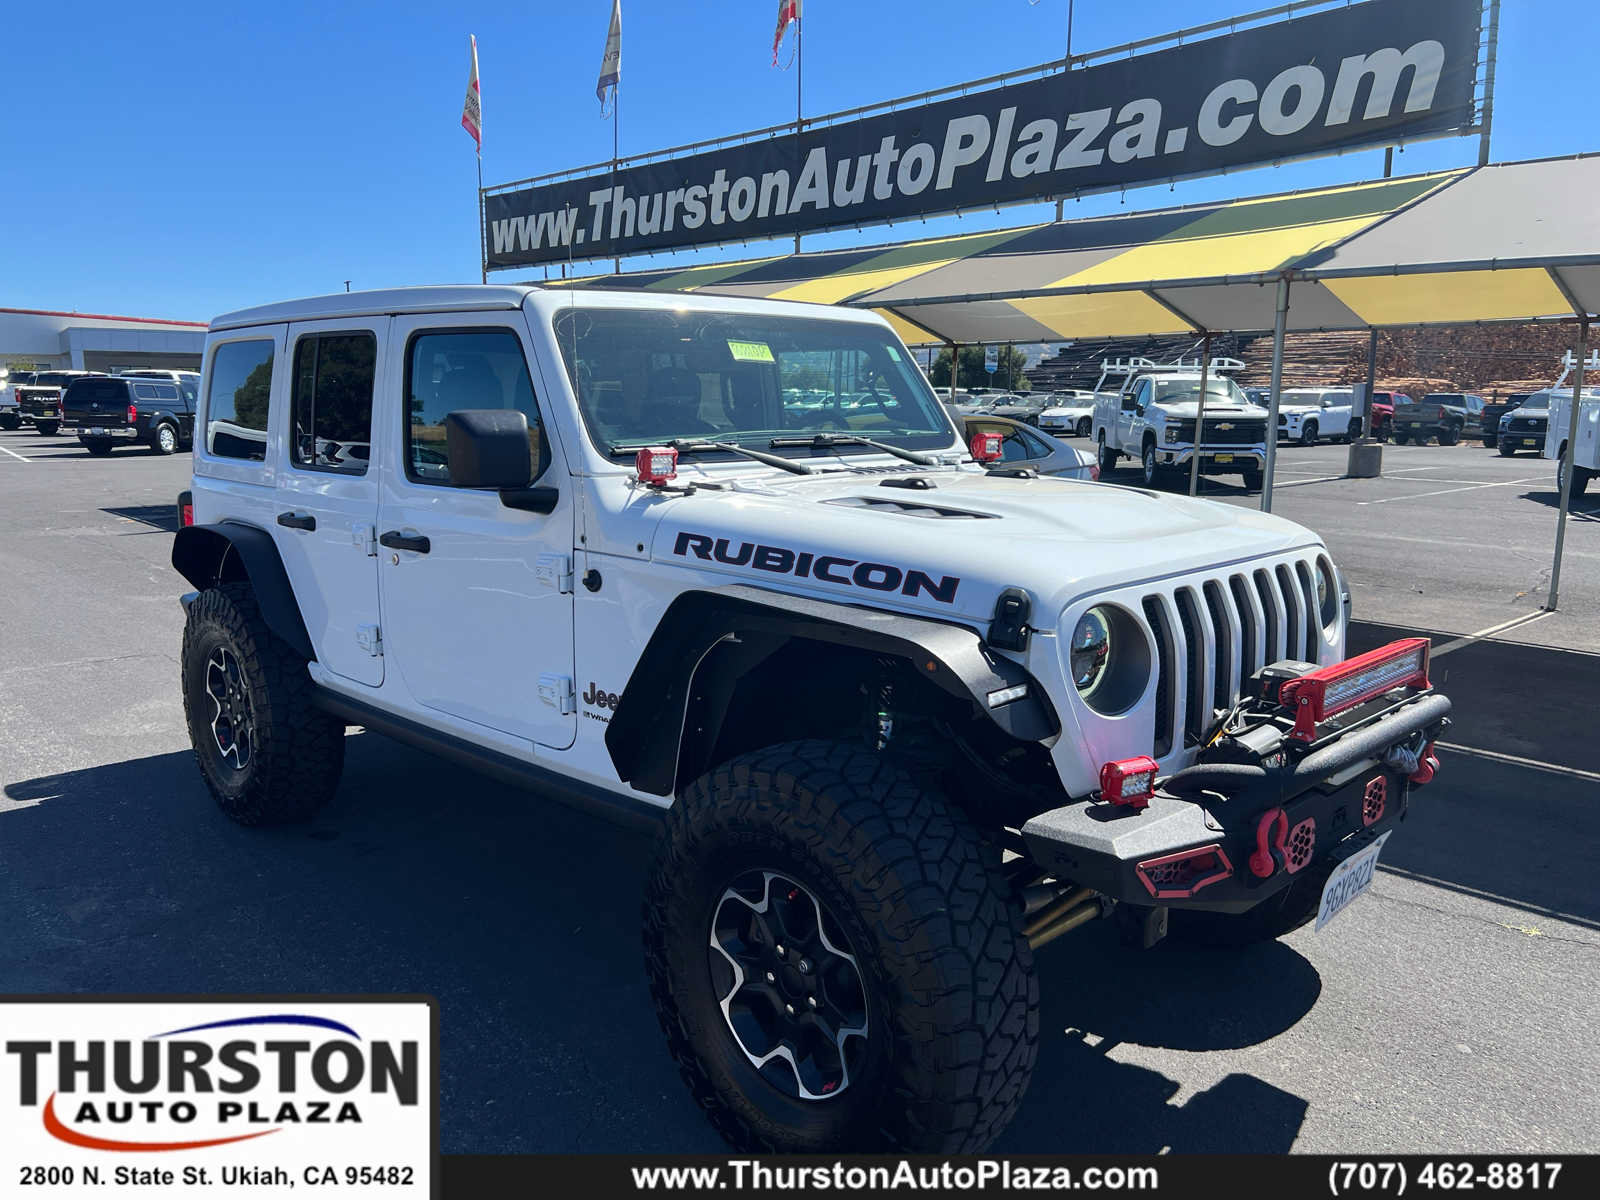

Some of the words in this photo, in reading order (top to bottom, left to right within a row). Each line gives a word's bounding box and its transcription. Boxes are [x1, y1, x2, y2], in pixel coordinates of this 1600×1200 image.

[492, 39, 1445, 254] www.ThurstonAutoPlaza.com
[673, 531, 961, 604] RUBICON
[583, 681, 620, 711] Jee
